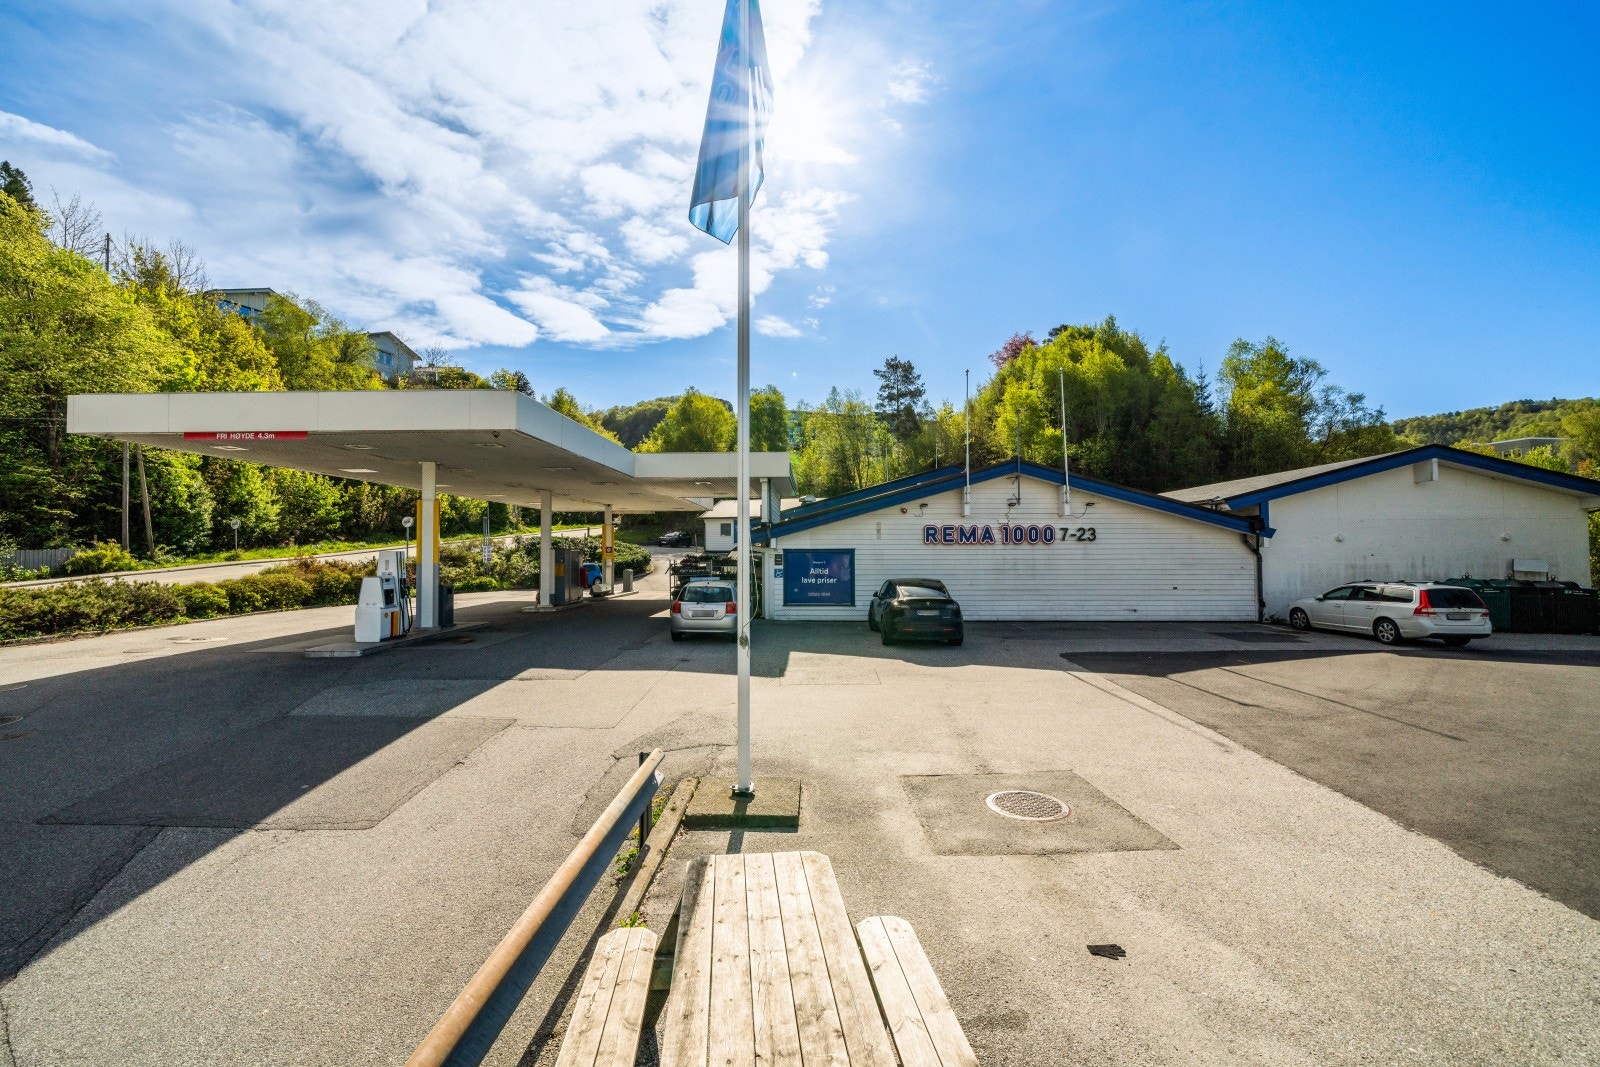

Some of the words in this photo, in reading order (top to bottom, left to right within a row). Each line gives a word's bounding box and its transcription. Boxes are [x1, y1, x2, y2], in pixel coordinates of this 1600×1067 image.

[923, 524, 996, 545] REMA
[1000, 524, 1056, 545] 1000
[1059, 527, 1097, 542] 7-23
[817, 577, 837, 585] priser
